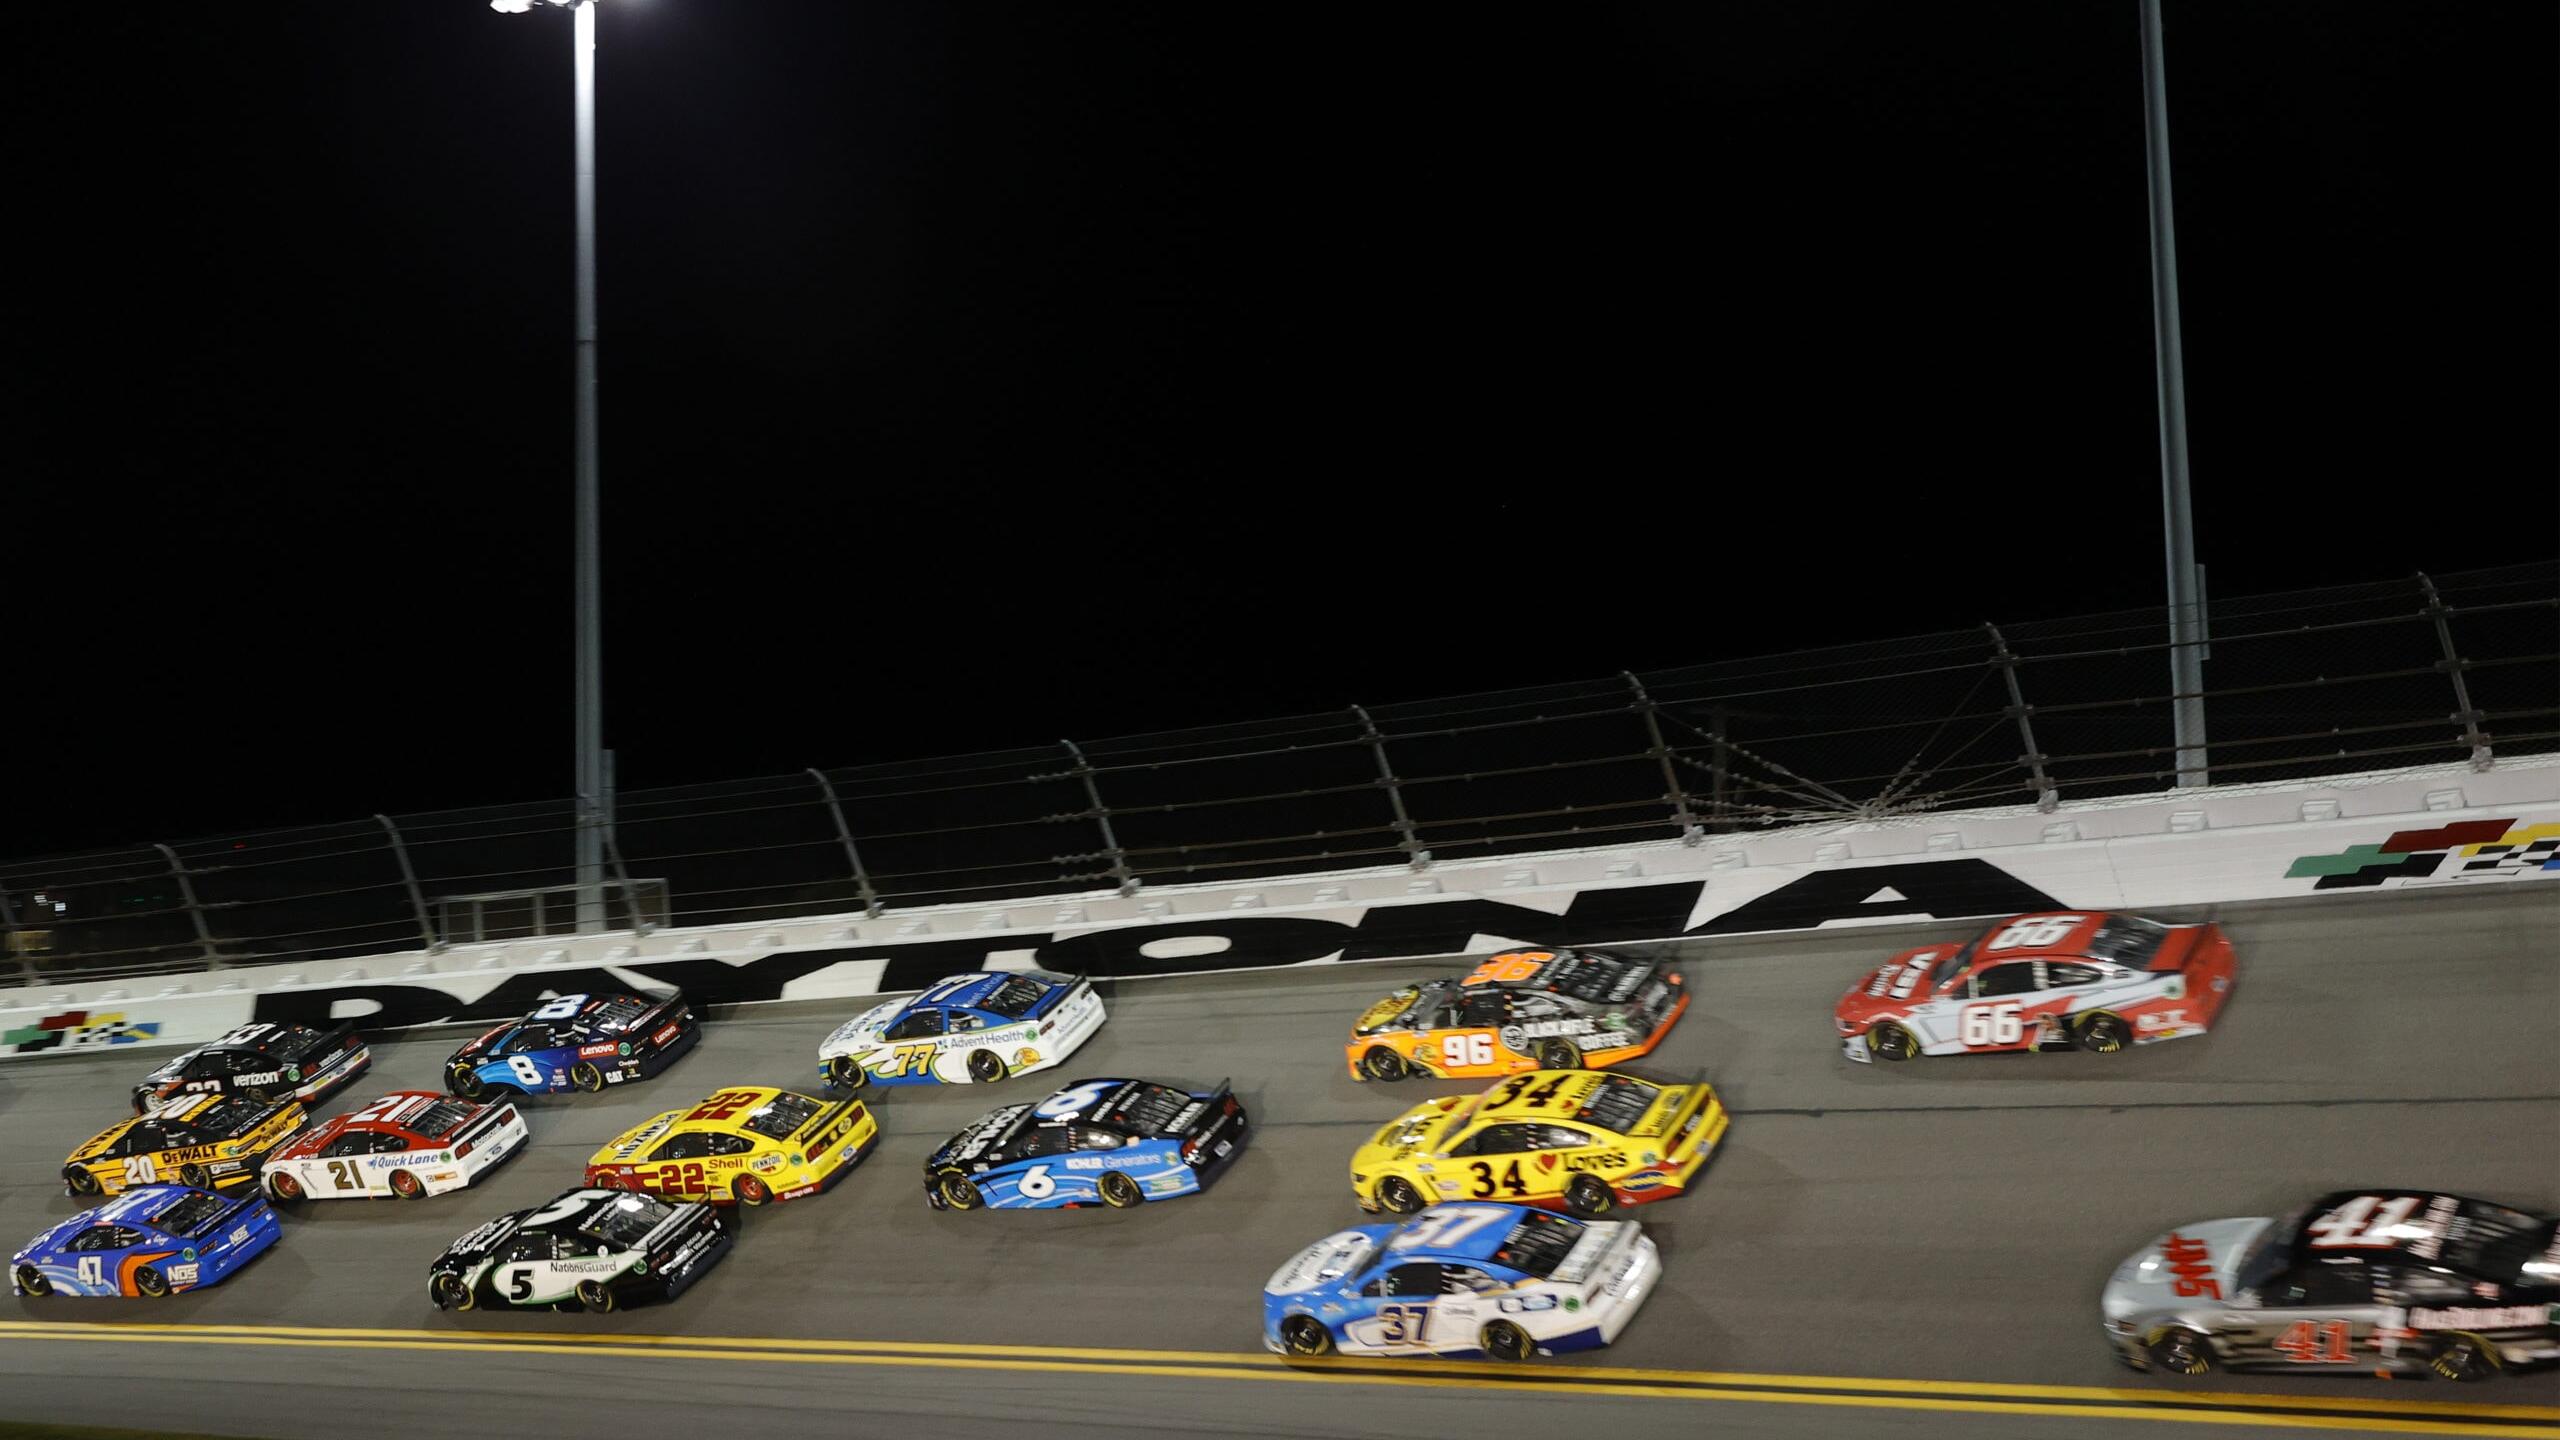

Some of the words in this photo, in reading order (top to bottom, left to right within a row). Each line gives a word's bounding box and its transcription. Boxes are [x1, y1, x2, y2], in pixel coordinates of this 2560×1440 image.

[253, 857, 2075, 1032] DAYTONA
[1987, 915, 2087, 951] 66
[1459, 952, 1555, 987] 96
[532, 993, 590, 1021] 8
[950, 1030, 1025, 1048] AdventHealth
[1961, 1003, 2023, 1046] 66
[581, 1043, 615, 1056] Lenovo
[892, 1043, 938, 1077] 77
[1442, 1033, 1494, 1067] 96
[233, 1070, 279, 1088] verizon
[507, 1055, 544, 1086] 8
[605, 1070, 624, 1083] CAT
[684, 1092, 762, 1121] 22
[1030, 1081, 1126, 1119] 6
[1483, 1073, 1574, 1112] 34
[346, 1095, 424, 1122] 21
[123, 1156, 157, 1185] 20
[327, 1159, 365, 1190] 21
[377, 1154, 407, 1169] Quick
[407, 1153, 439, 1167] Lane
[708, 1158, 743, 1169] Shell
[752, 1155, 781, 1170] PENNZOIL
[659, 1163, 707, 1195] 22
[1018, 1165, 1056, 1199] 6
[1468, 1159, 1529, 1198] 34
[1388, 1206, 1513, 1250] 37
[2307, 1195, 2426, 1249] 41
[77, 1256, 102, 1286] 47
[167, 1263, 199, 1283] NOS
[550, 1261, 618, 1275] NationsGuard
[510, 1269, 536, 1301] 5
[1376, 1303, 1432, 1345] 37
[2272, 1319, 2358, 1364] 41
